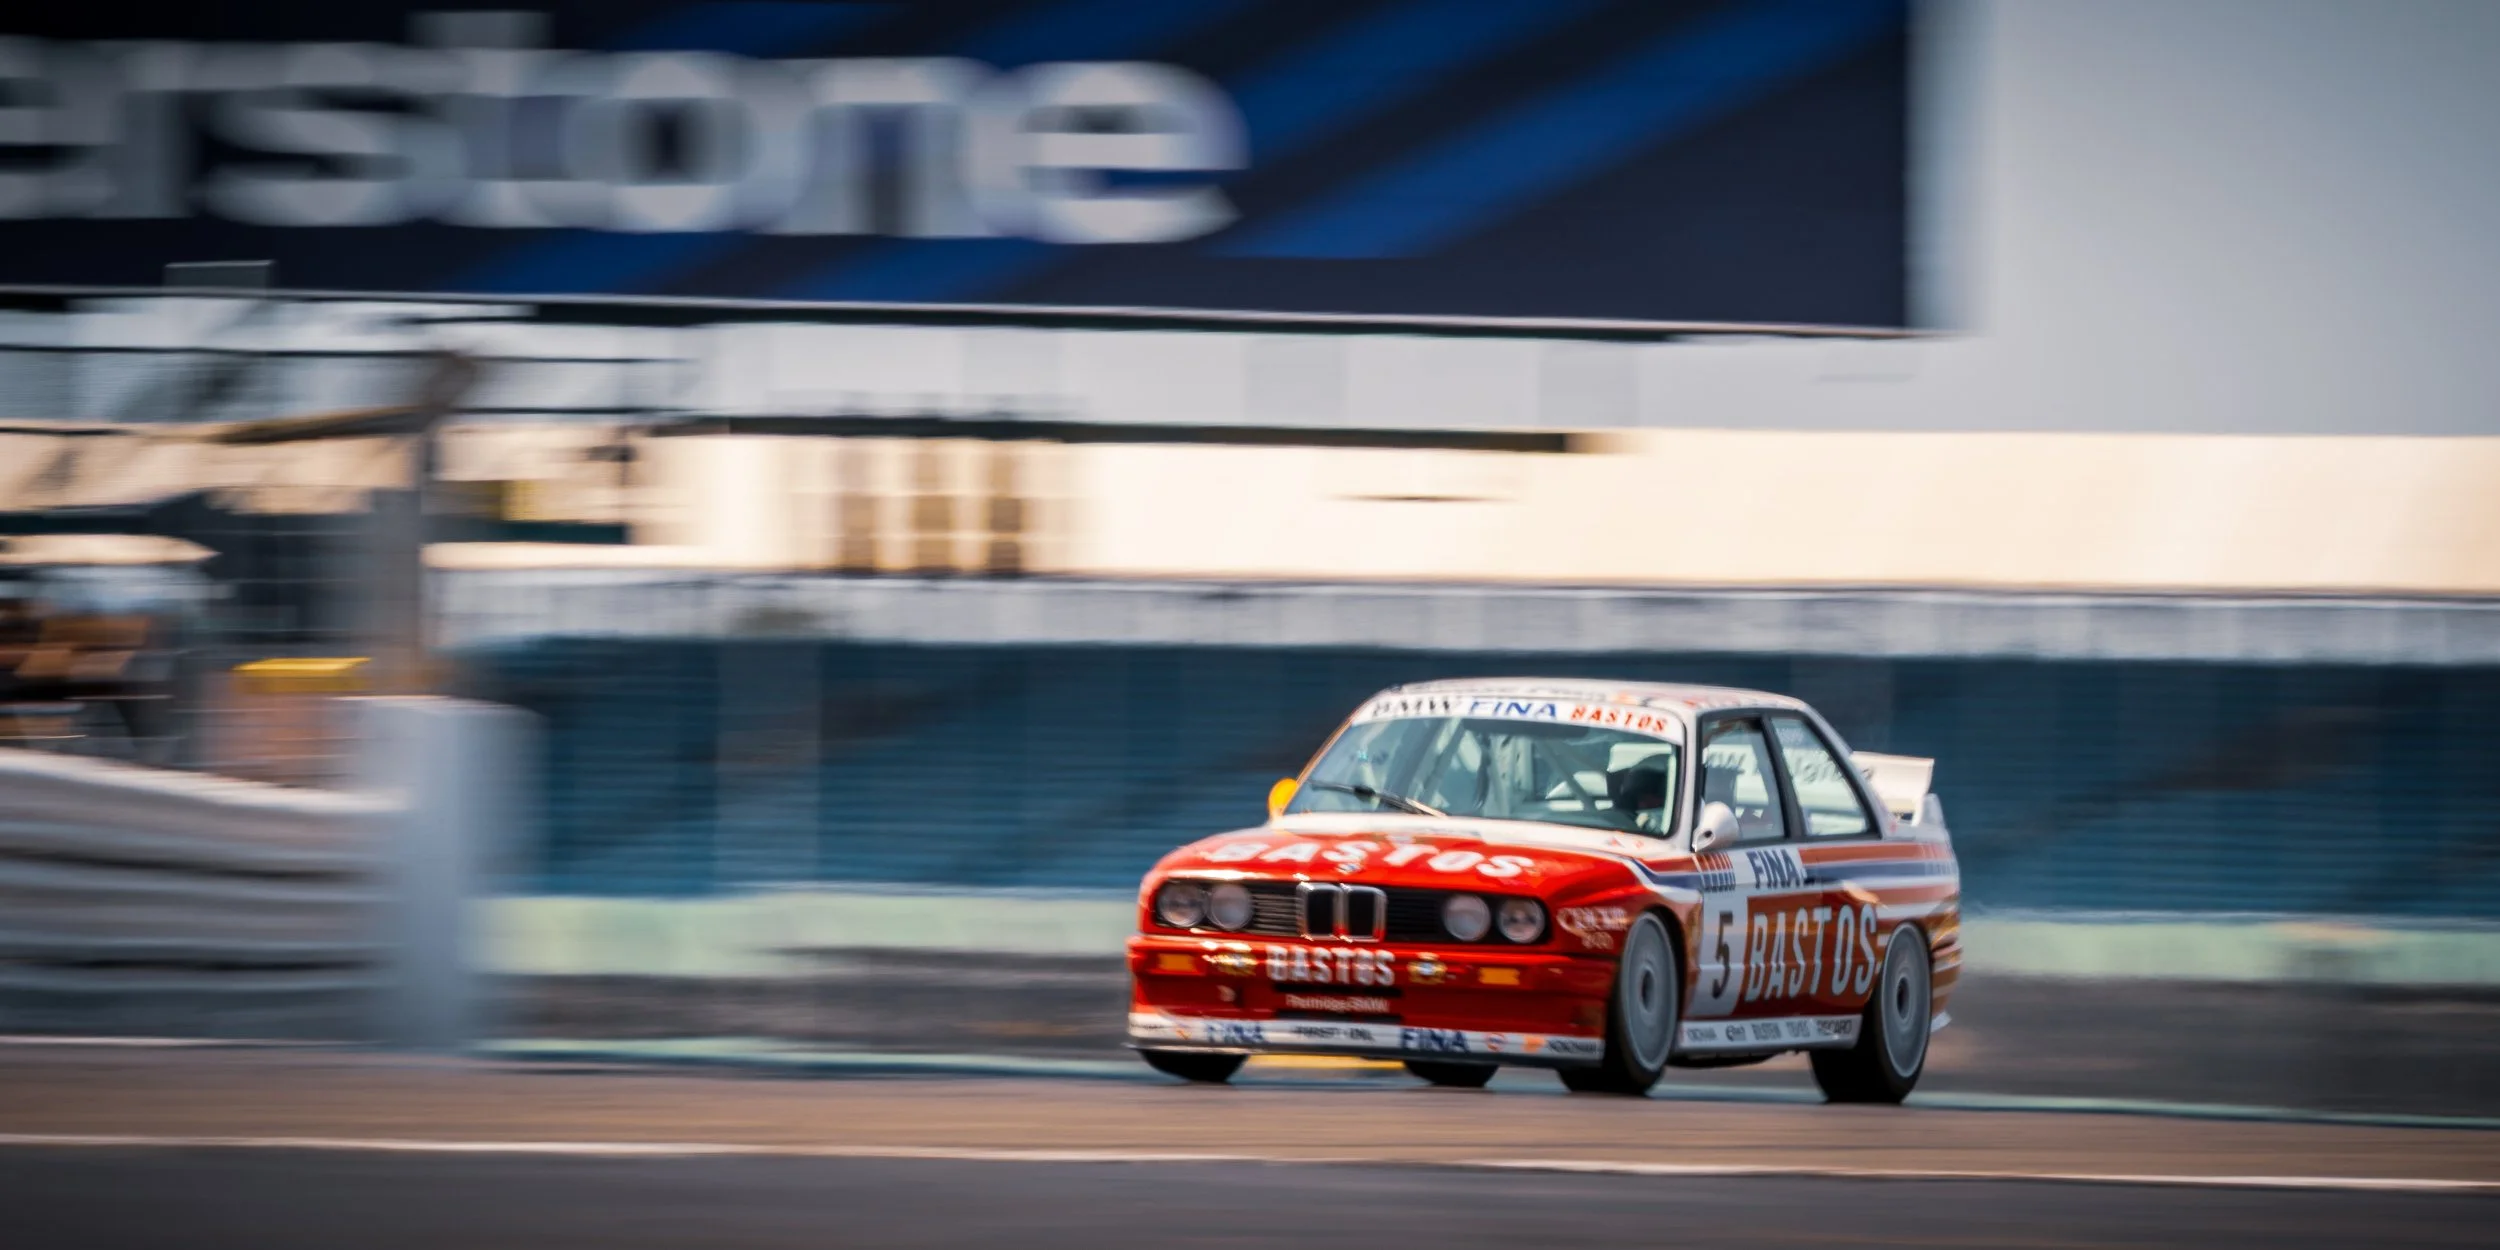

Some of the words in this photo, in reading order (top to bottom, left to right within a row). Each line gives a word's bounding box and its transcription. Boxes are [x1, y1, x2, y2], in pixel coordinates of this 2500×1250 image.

[1468, 702, 1557, 718] FINA
[1570, 705, 1667, 733] BASTOS
[1201, 841, 1535, 877] BASTOS
[1747, 848, 1801, 890] FINA
[1266, 944, 1396, 986] BASTOS
[1711, 910, 1734, 1000] 5
[1744, 903, 1878, 1003] BASTOS
[1401, 1026, 1472, 1052] FINA
